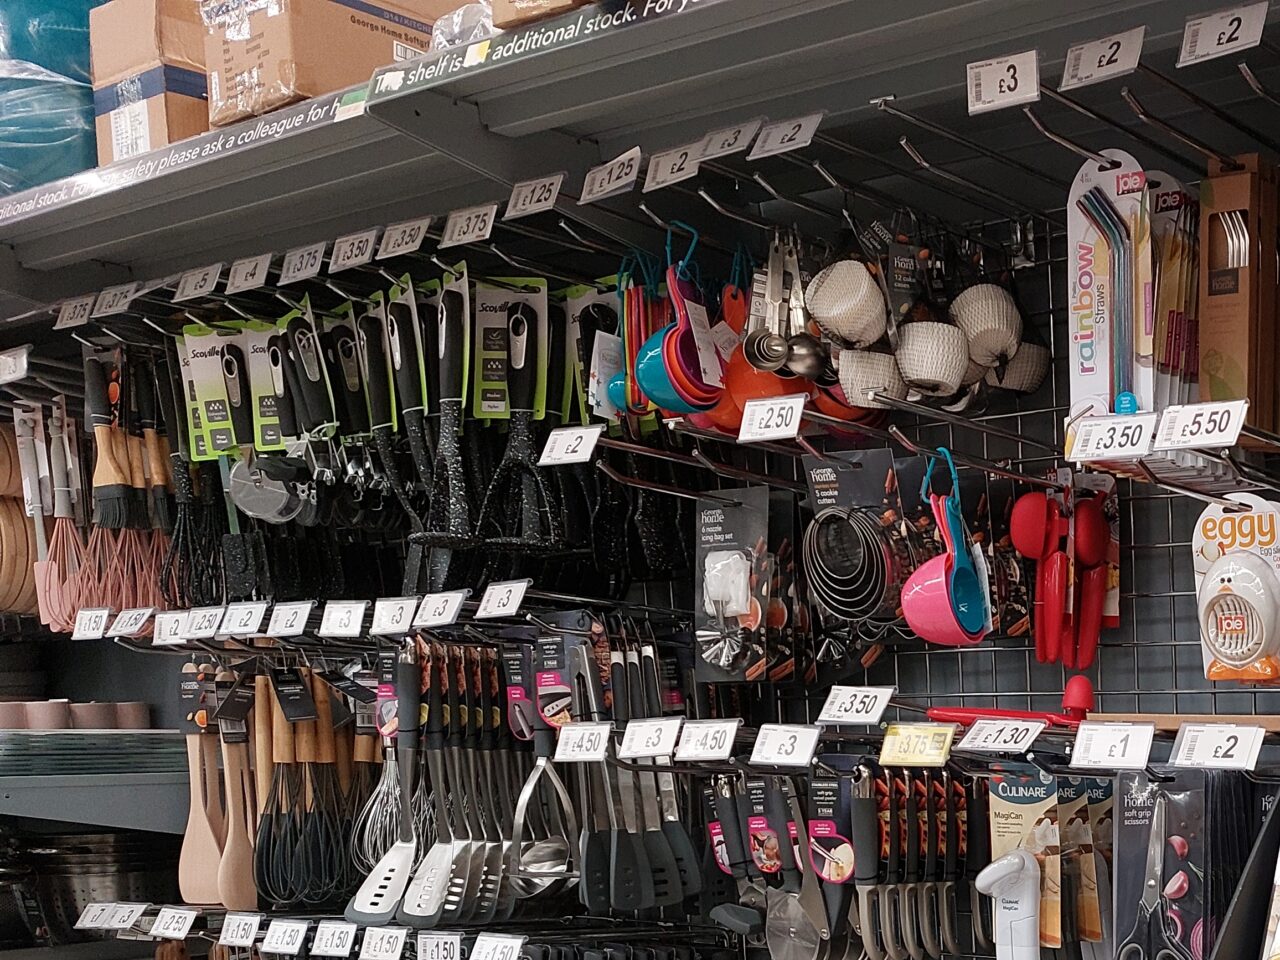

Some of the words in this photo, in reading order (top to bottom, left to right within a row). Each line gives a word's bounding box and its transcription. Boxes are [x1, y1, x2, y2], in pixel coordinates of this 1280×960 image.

[351, 15, 378, 28] George
[380, 25, 402, 37] Home
[492, 20, 581, 61] additional
[584, 4, 637, 34] stock.
[1217, 18, 1242, 45] £2
[1098, 42, 1121, 67] £2
[406, 58, 447, 85] shelf
[448, 56, 463, 73] is
[999, 65, 1018, 93] £3
[122, 162, 155, 184] safety
[157, 145, 199, 174] please
[202, 134, 224, 156] ask
[226, 136, 234, 147] a
[238, 117, 302, 146] colleague
[306, 104, 328, 124] for
[671, 152, 686, 174] £2
[194, 273, 208, 291] £5
[245, 266, 257, 281] £4
[1073, 244, 1094, 374] rainbow
[1096, 284, 1105, 324] Straws
[759, 408, 793, 430] £2.50
[1182, 410, 1230, 436] £5.50
[1096, 424, 1142, 449] £3.50
[1202, 512, 1277, 548] eggy
[1260, 547, 1271, 556] Egg
[499, 589, 512, 607] £3
[1220, 617, 1243, 632] joie
[838, 694, 877, 713] £3.50
[983, 727, 1028, 744] £1.30
[1108, 735, 1128, 758] £1
[999, 784, 1046, 797] CULINARE
[994, 812, 1023, 820] MagiCan
